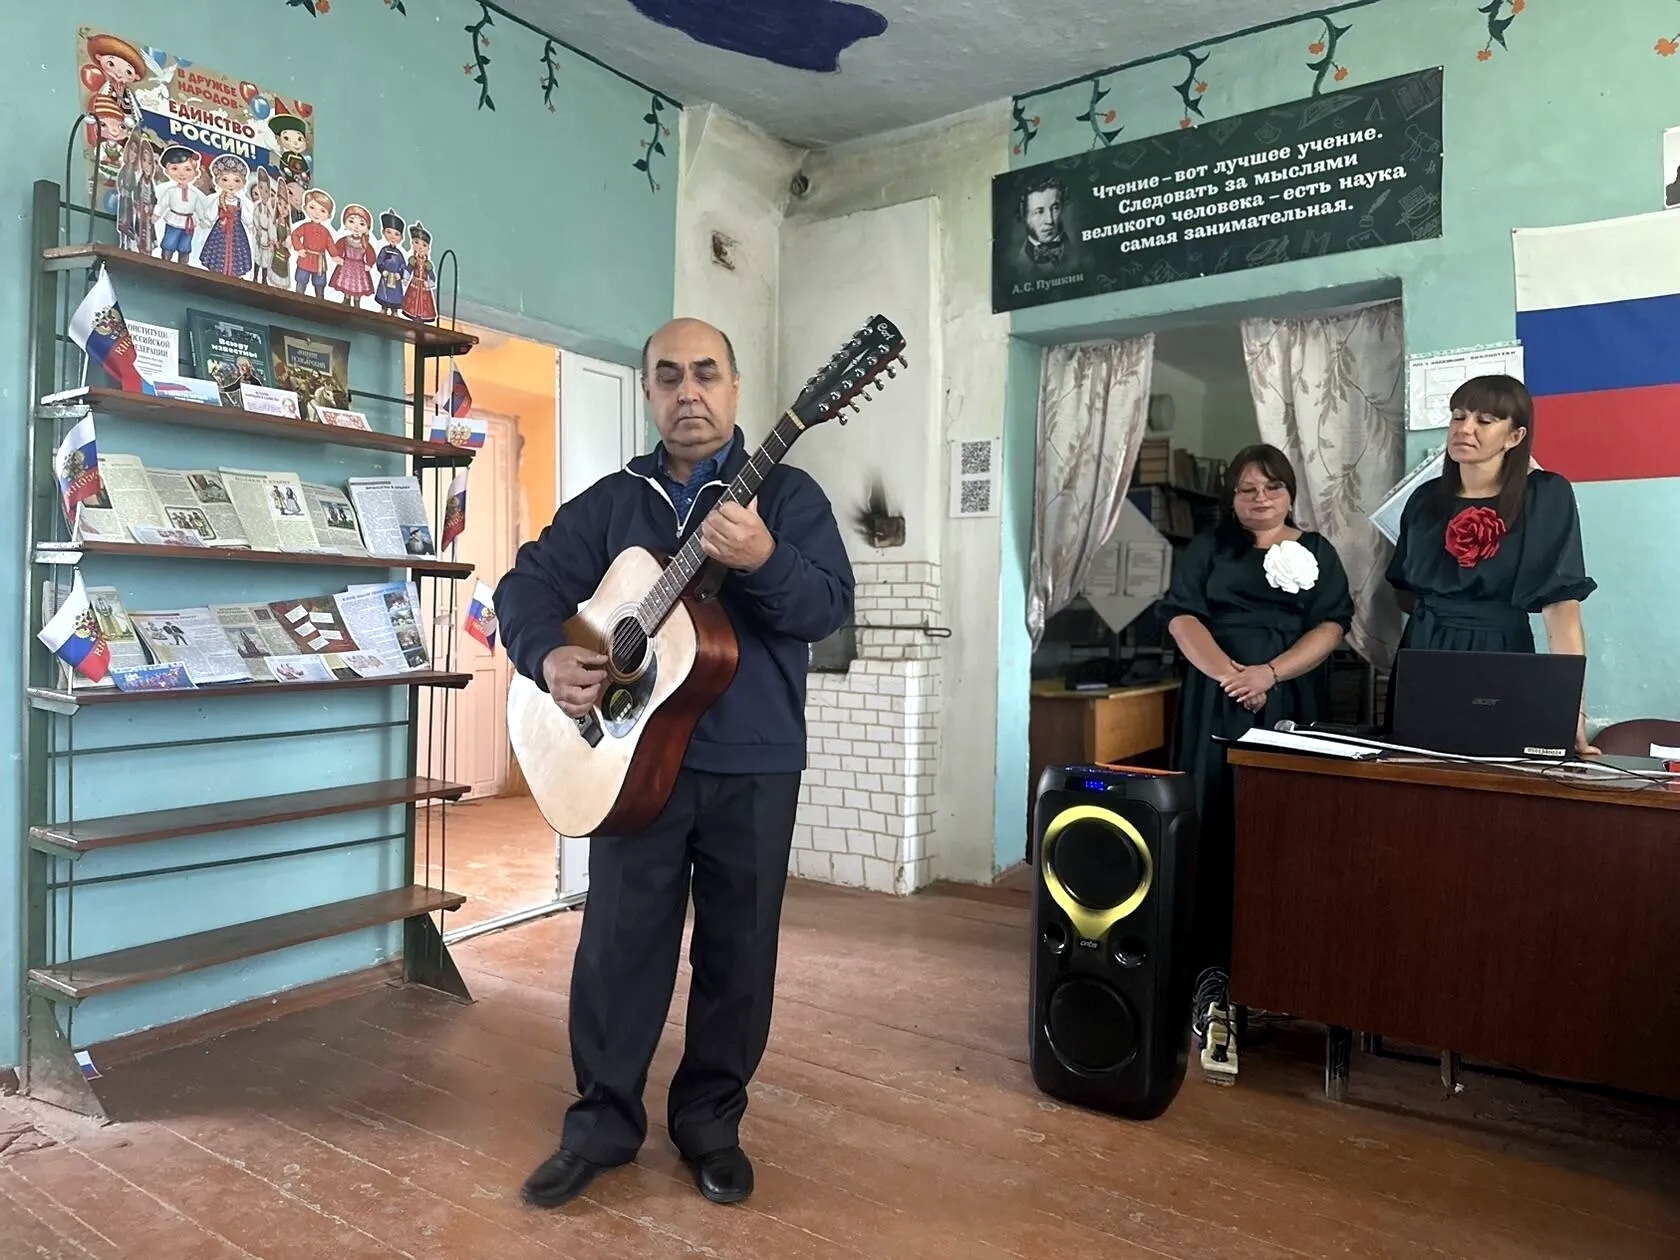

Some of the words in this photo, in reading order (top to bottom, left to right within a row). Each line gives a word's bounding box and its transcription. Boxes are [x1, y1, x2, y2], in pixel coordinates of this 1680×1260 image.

[177, 68, 185, 78] В
[188, 73, 238, 97] ДРУЖБЕ
[168, 99, 256, 139] ЕДИНСТВО
[169, 118, 257, 160] РОССИИ!
[1092, 175, 1160, 199] Чтение
[1174, 164, 1209, 183] вот
[1213, 146, 1291, 175] лучшее
[1297, 127, 1383, 160] учение.
[1118, 183, 1219, 214] Следовать
[1224, 176, 1248, 192] за
[1254, 153, 1358, 186] мыслями
[1081, 214, 1166, 242] великого
[1171, 194, 1265, 222] человека
[1283, 181, 1332, 201] есть
[1338, 165, 1407, 190] наука
[1120, 231, 1179, 253] самая
[1183, 199, 1354, 241] занимательная.
[1036, 273, 1084, 290] Пушкин
